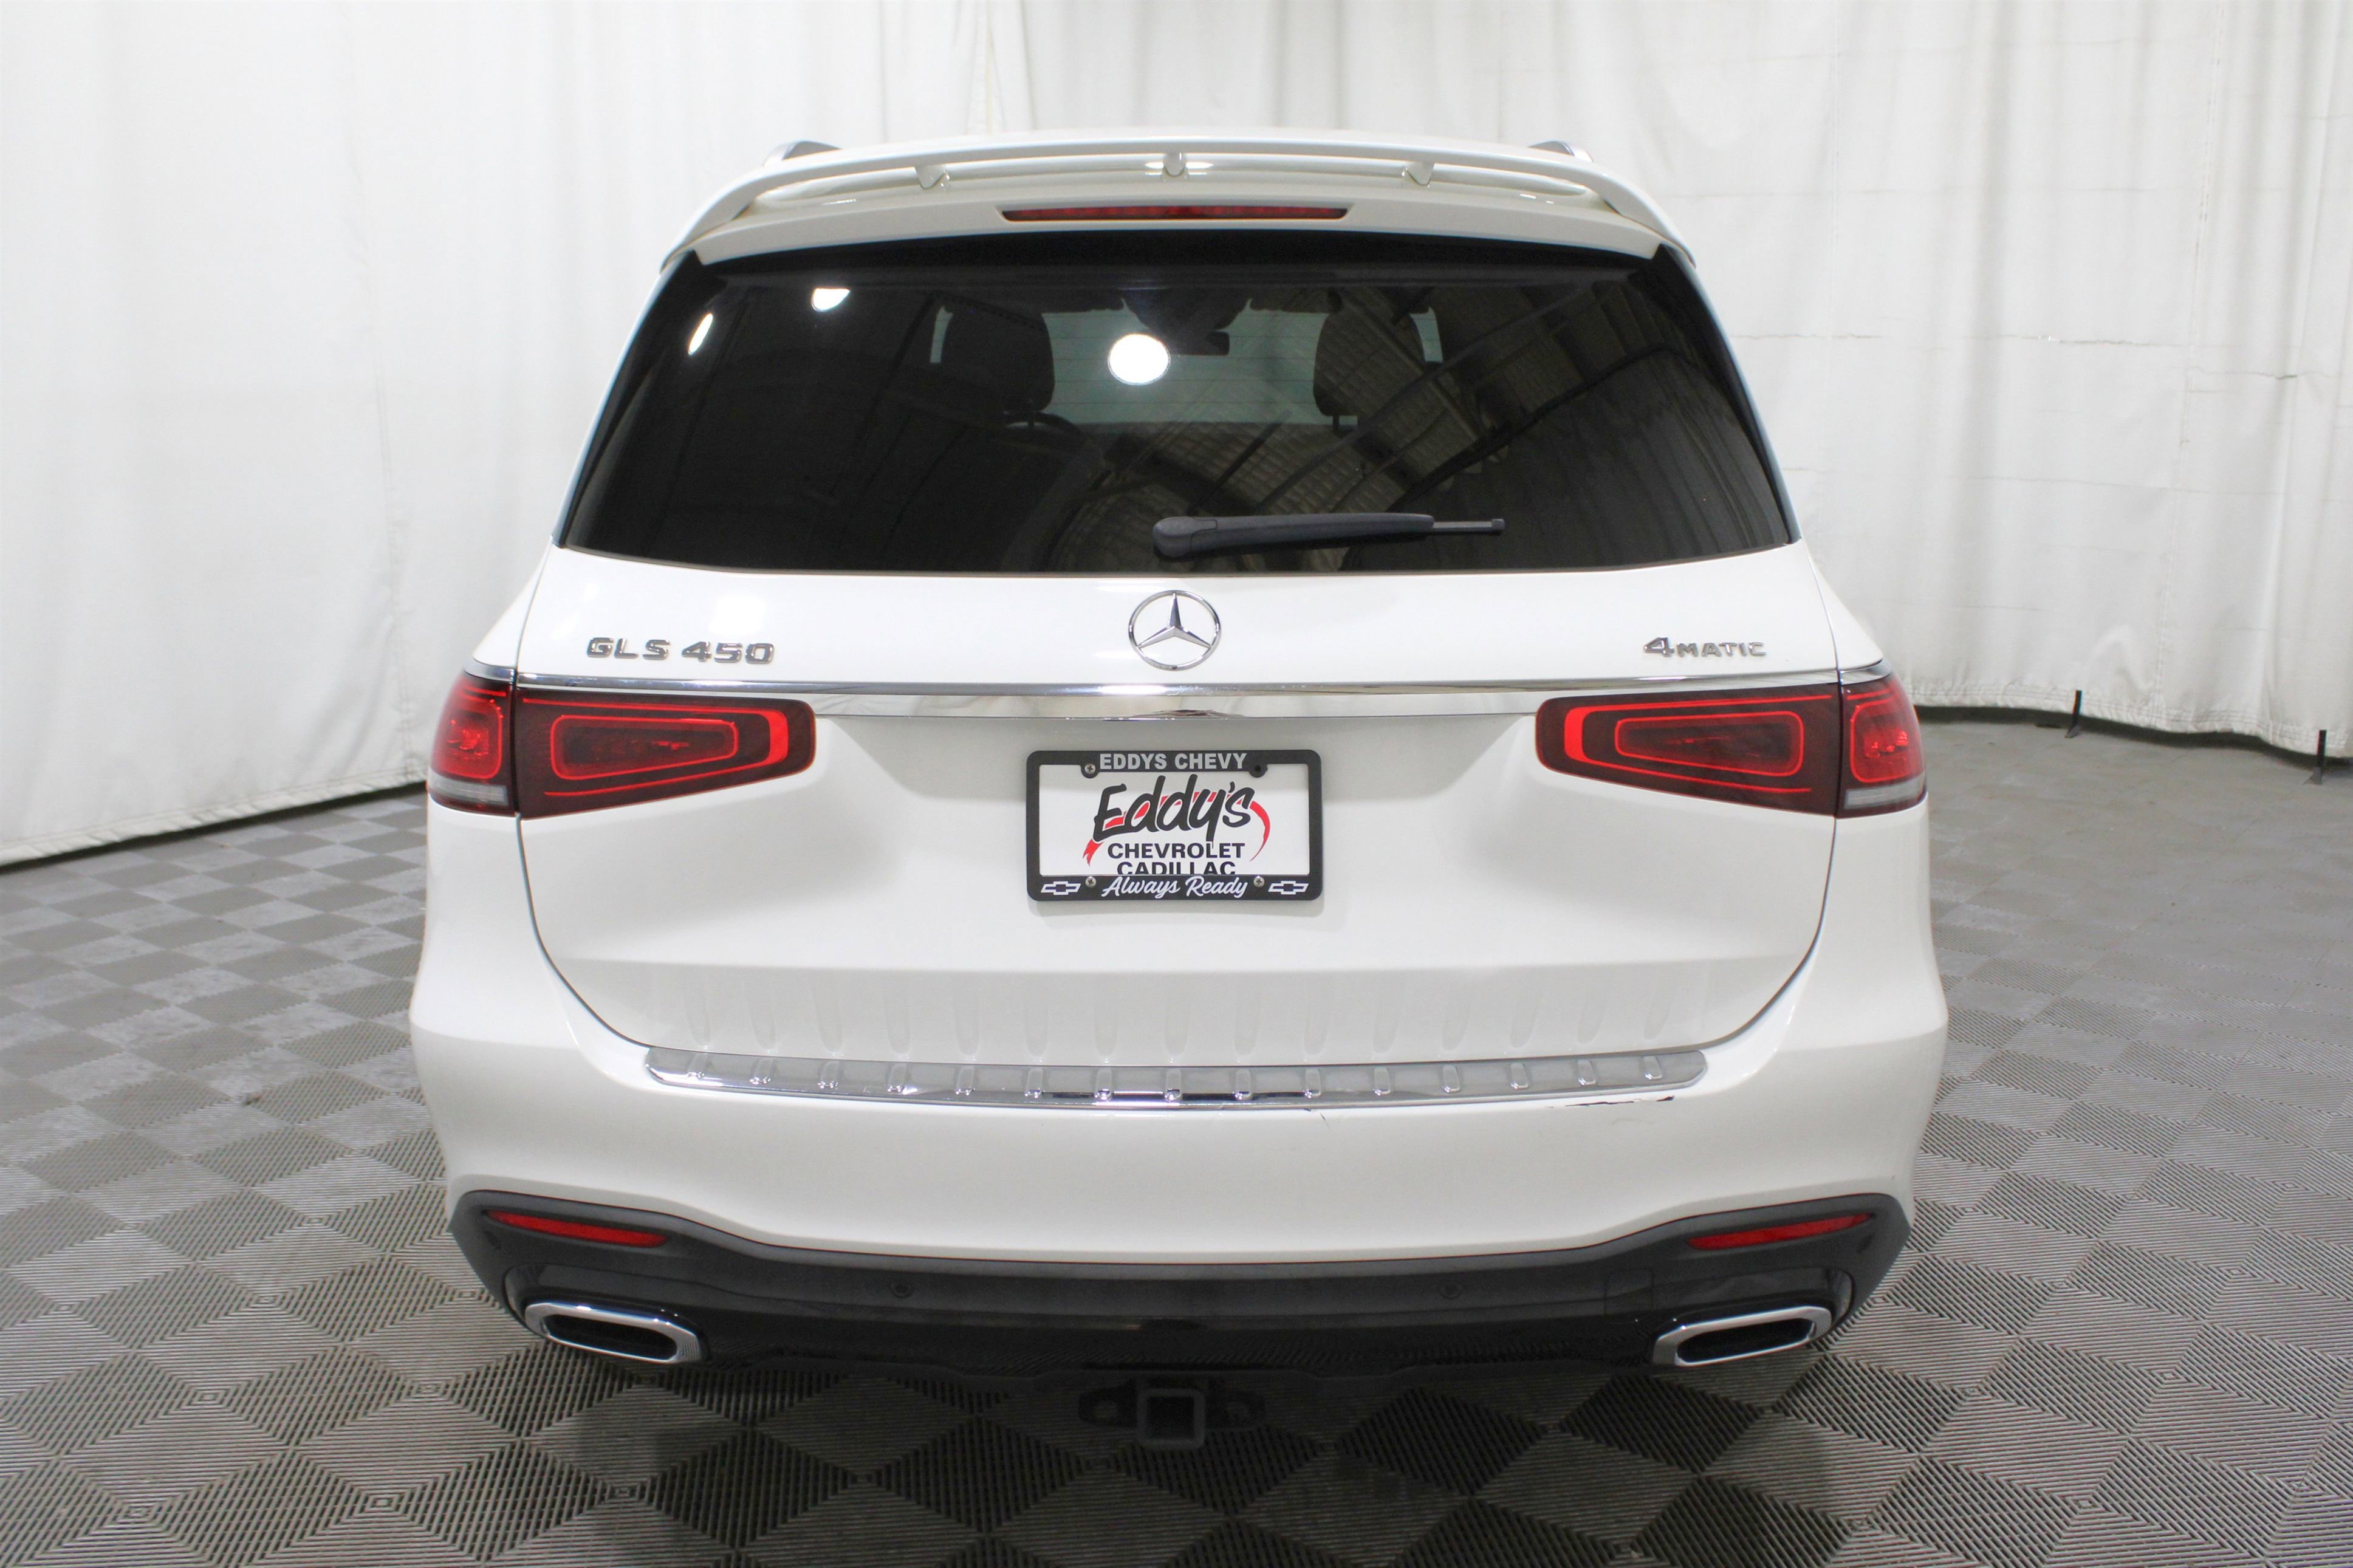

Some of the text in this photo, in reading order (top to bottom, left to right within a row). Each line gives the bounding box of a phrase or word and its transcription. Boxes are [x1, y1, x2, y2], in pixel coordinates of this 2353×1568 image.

[586, 637, 775, 664] GLS 450
[1644, 637, 1767, 657] 4MATIC
[1099, 753, 1247, 770] EDDYS CHEVY
[1093, 773, 1255, 849] Eddy's
[1107, 843, 1245, 859] CHEVROLET
[1101, 875, 1248, 899] Always Ready
